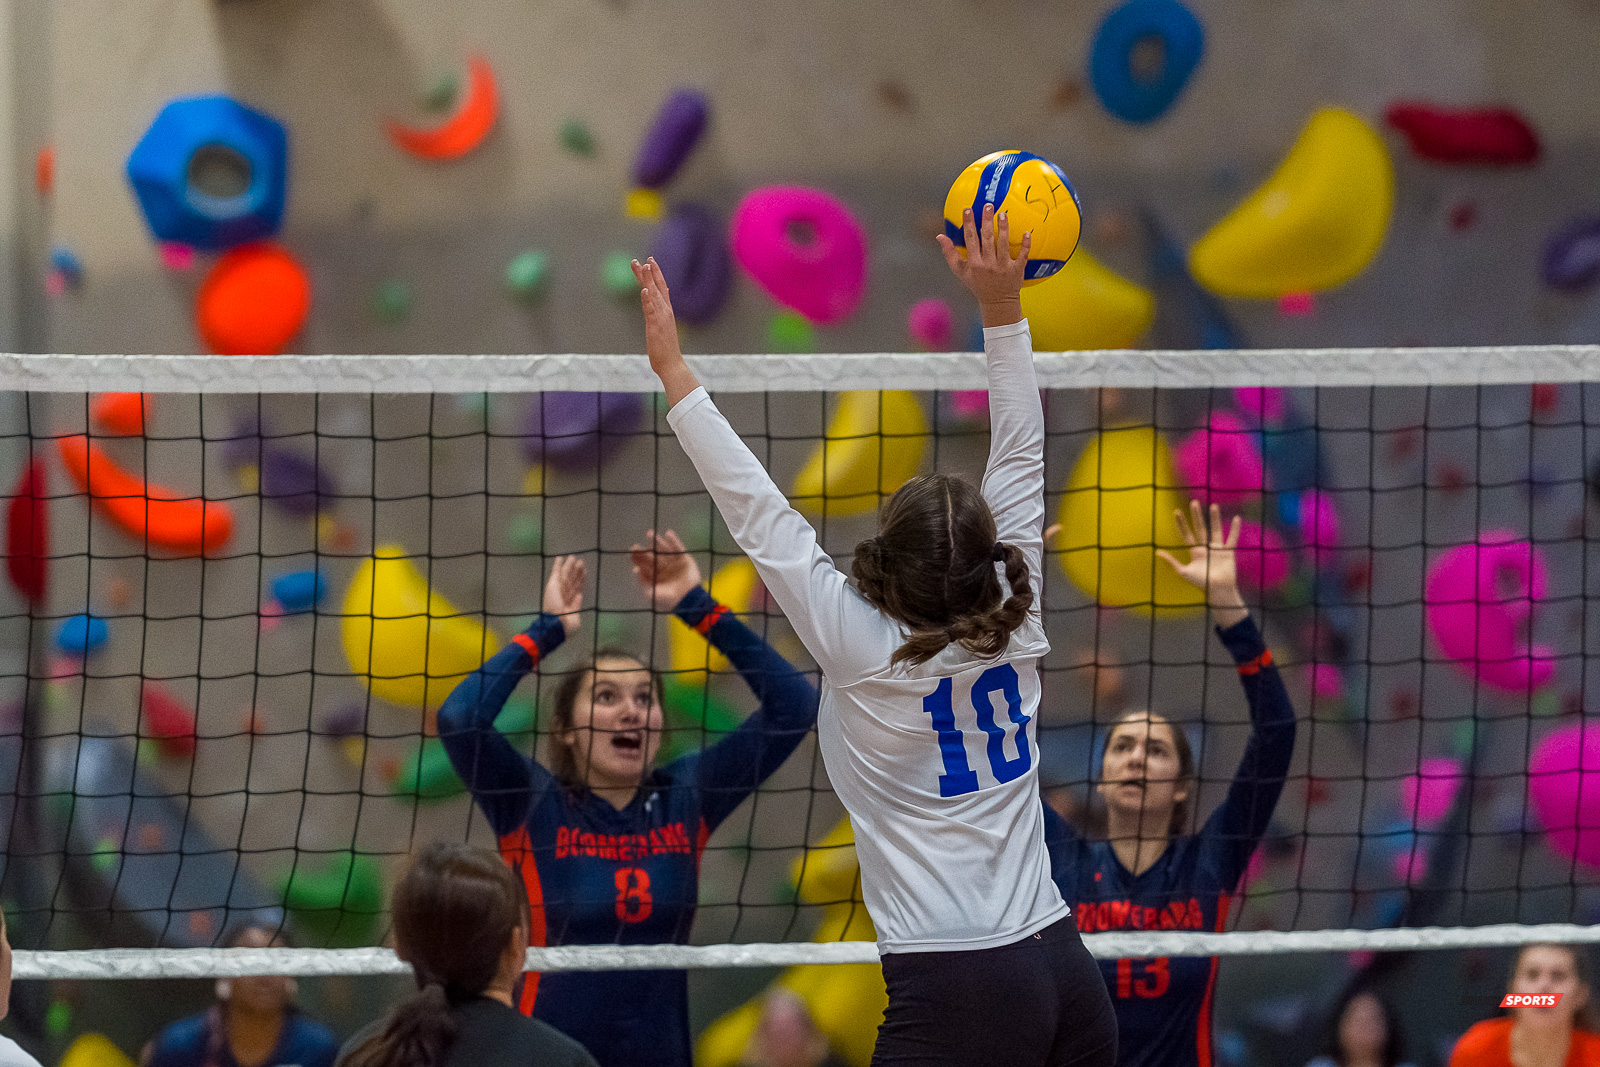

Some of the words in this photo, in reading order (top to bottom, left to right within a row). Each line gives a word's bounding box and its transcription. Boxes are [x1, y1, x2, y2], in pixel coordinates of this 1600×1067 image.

[918, 663, 1031, 797] 10
[614, 867, 652, 923] 8
[1117, 957, 1170, 998] 13
